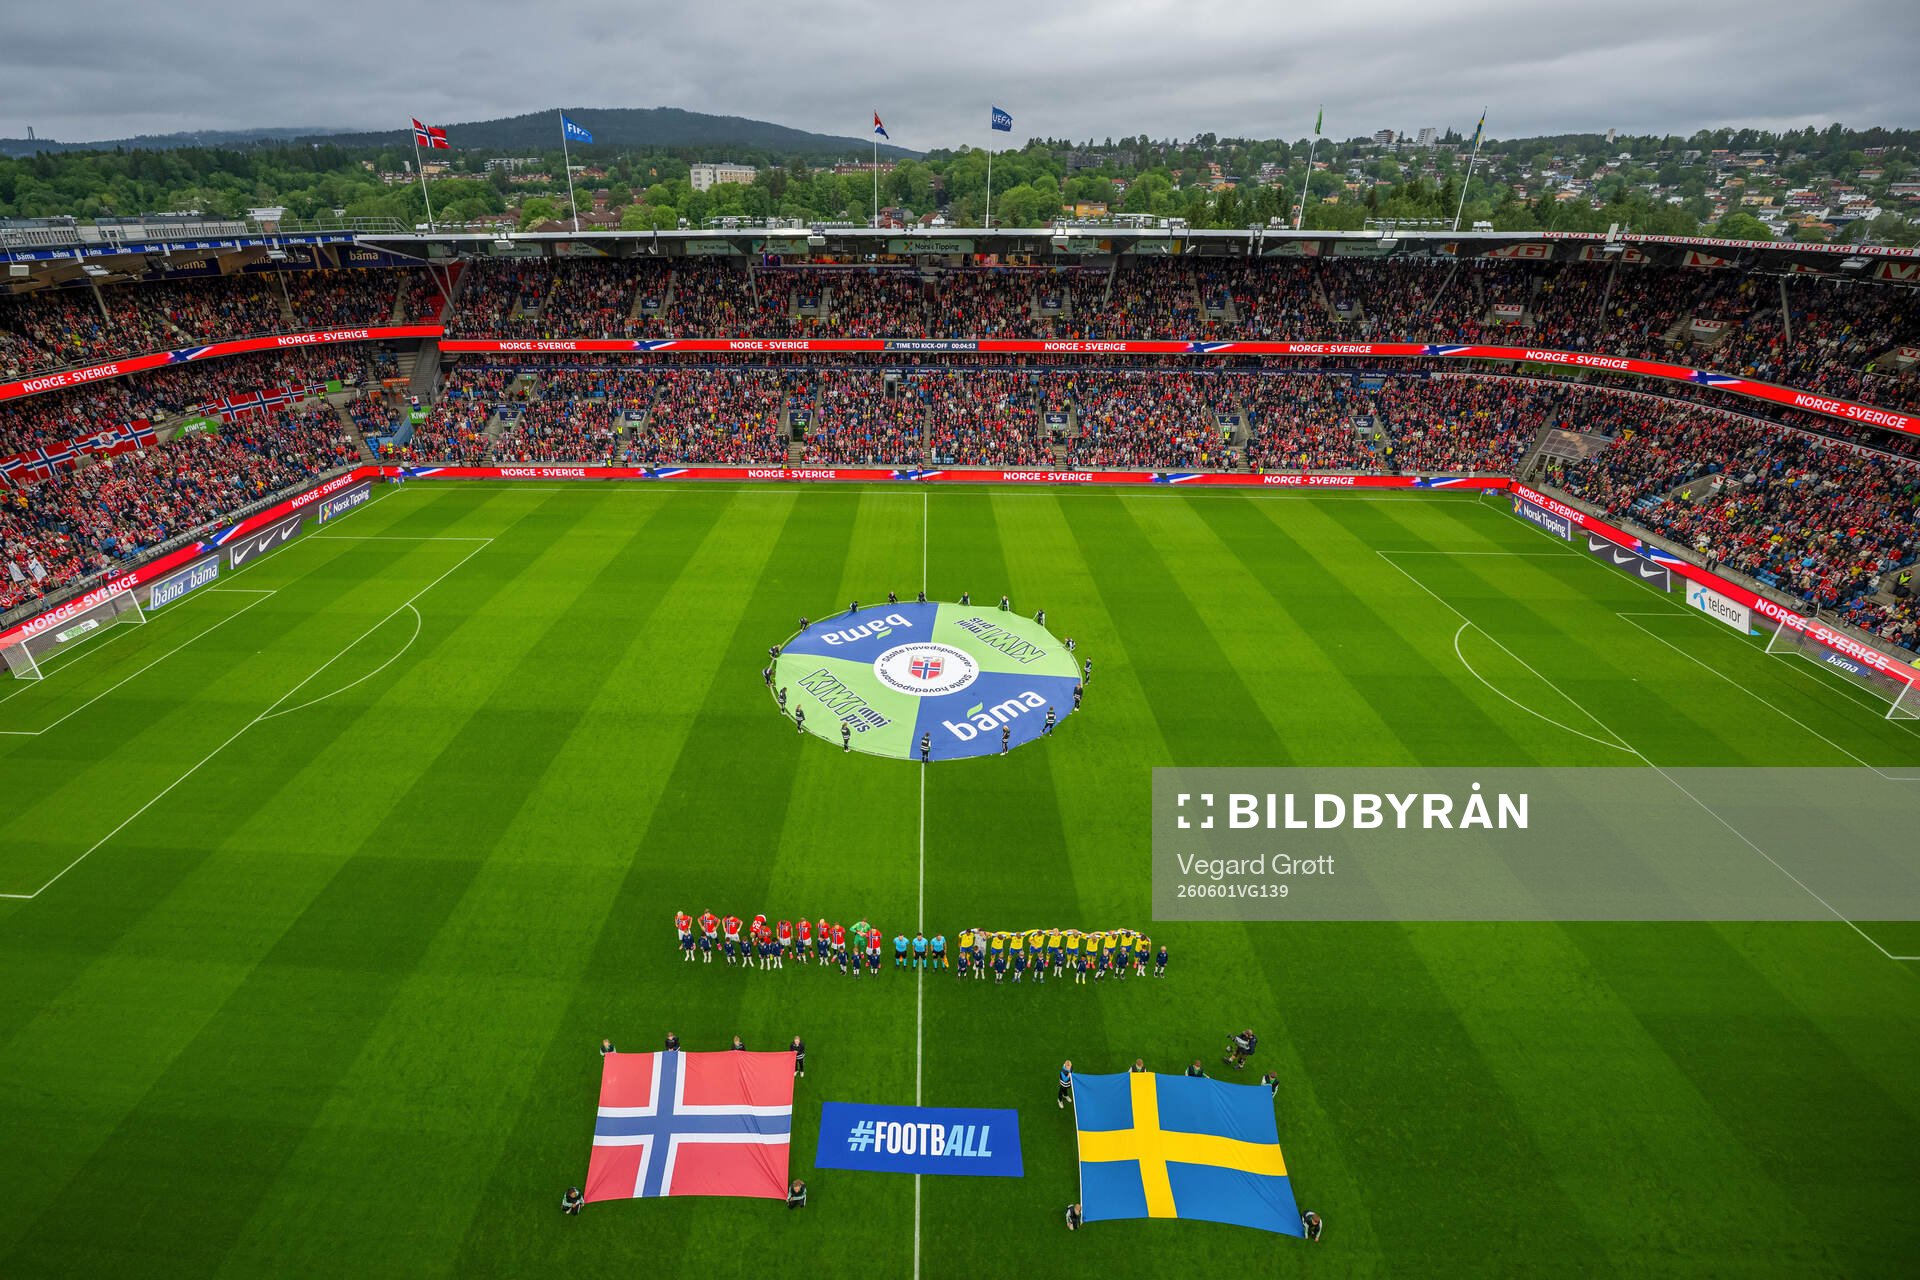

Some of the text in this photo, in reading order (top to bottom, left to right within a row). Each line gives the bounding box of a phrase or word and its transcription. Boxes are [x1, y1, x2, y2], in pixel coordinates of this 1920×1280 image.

[350, 251, 379, 261] bama
[278, 334, 316, 345] NORGE
[324, 331, 368, 341] SVERIGE
[499, 342, 531, 350] NORGE
[538, 342, 576, 350] SVERIGE
[730, 342, 763, 350] NORGE
[770, 342, 809, 350] SVERIGE
[1045, 343, 1078, 351] NORGE
[1085, 343, 1126, 351] SVERIGE
[1290, 345, 1323, 353] NORGE
[1330, 345, 1372, 353] SVERIGE
[1526, 350, 1568, 363] NORGE
[1576, 355, 1629, 369] SVERIGE
[23, 376, 66, 392] NORGE
[73, 365, 118, 382] SVERIGE
[1795, 395, 1840, 413] NORGE
[1847, 406, 1908, 428] SVERIGE
[500, 469, 536, 477] NORGE
[543, 469, 585, 477] SVERIGE
[749, 470, 784, 478] NORGE
[791, 470, 836, 478] SVERIGE
[1004, 472, 1040, 481] NORGE
[1048, 473, 1092, 481] SVERIGE
[1264, 476, 1302, 484] NORGE
[1309, 477, 1355, 485] SVERIGE
[292, 490, 319, 508] NORGE
[323, 474, 352, 494] SVERIGE
[333, 489, 370, 513] Norsk Tipping
[1518, 486, 1545, 504] NORGE
[1549, 501, 1585, 524] SVERIGE
[1524, 504, 1566, 538] Norsk Tipping
[154, 564, 218, 607] bama bama
[22, 603, 76, 635] NORGE
[83, 573, 138, 607] SVERIGE
[1708, 595, 1742, 624] telenor
[820, 613, 913, 645] bama
[1754, 599, 1890, 671] NORGE SVERIGE
[980, 628, 1047, 665] KIWI
[1827, 655, 1859, 673] bama
[797, 668, 867, 716] KIWI
[840, 713, 871, 733] pris
[858, 706, 892, 728] mini
[942, 690, 1046, 742] bama
[848, 1120, 992, 1158] #FOOTBALL
